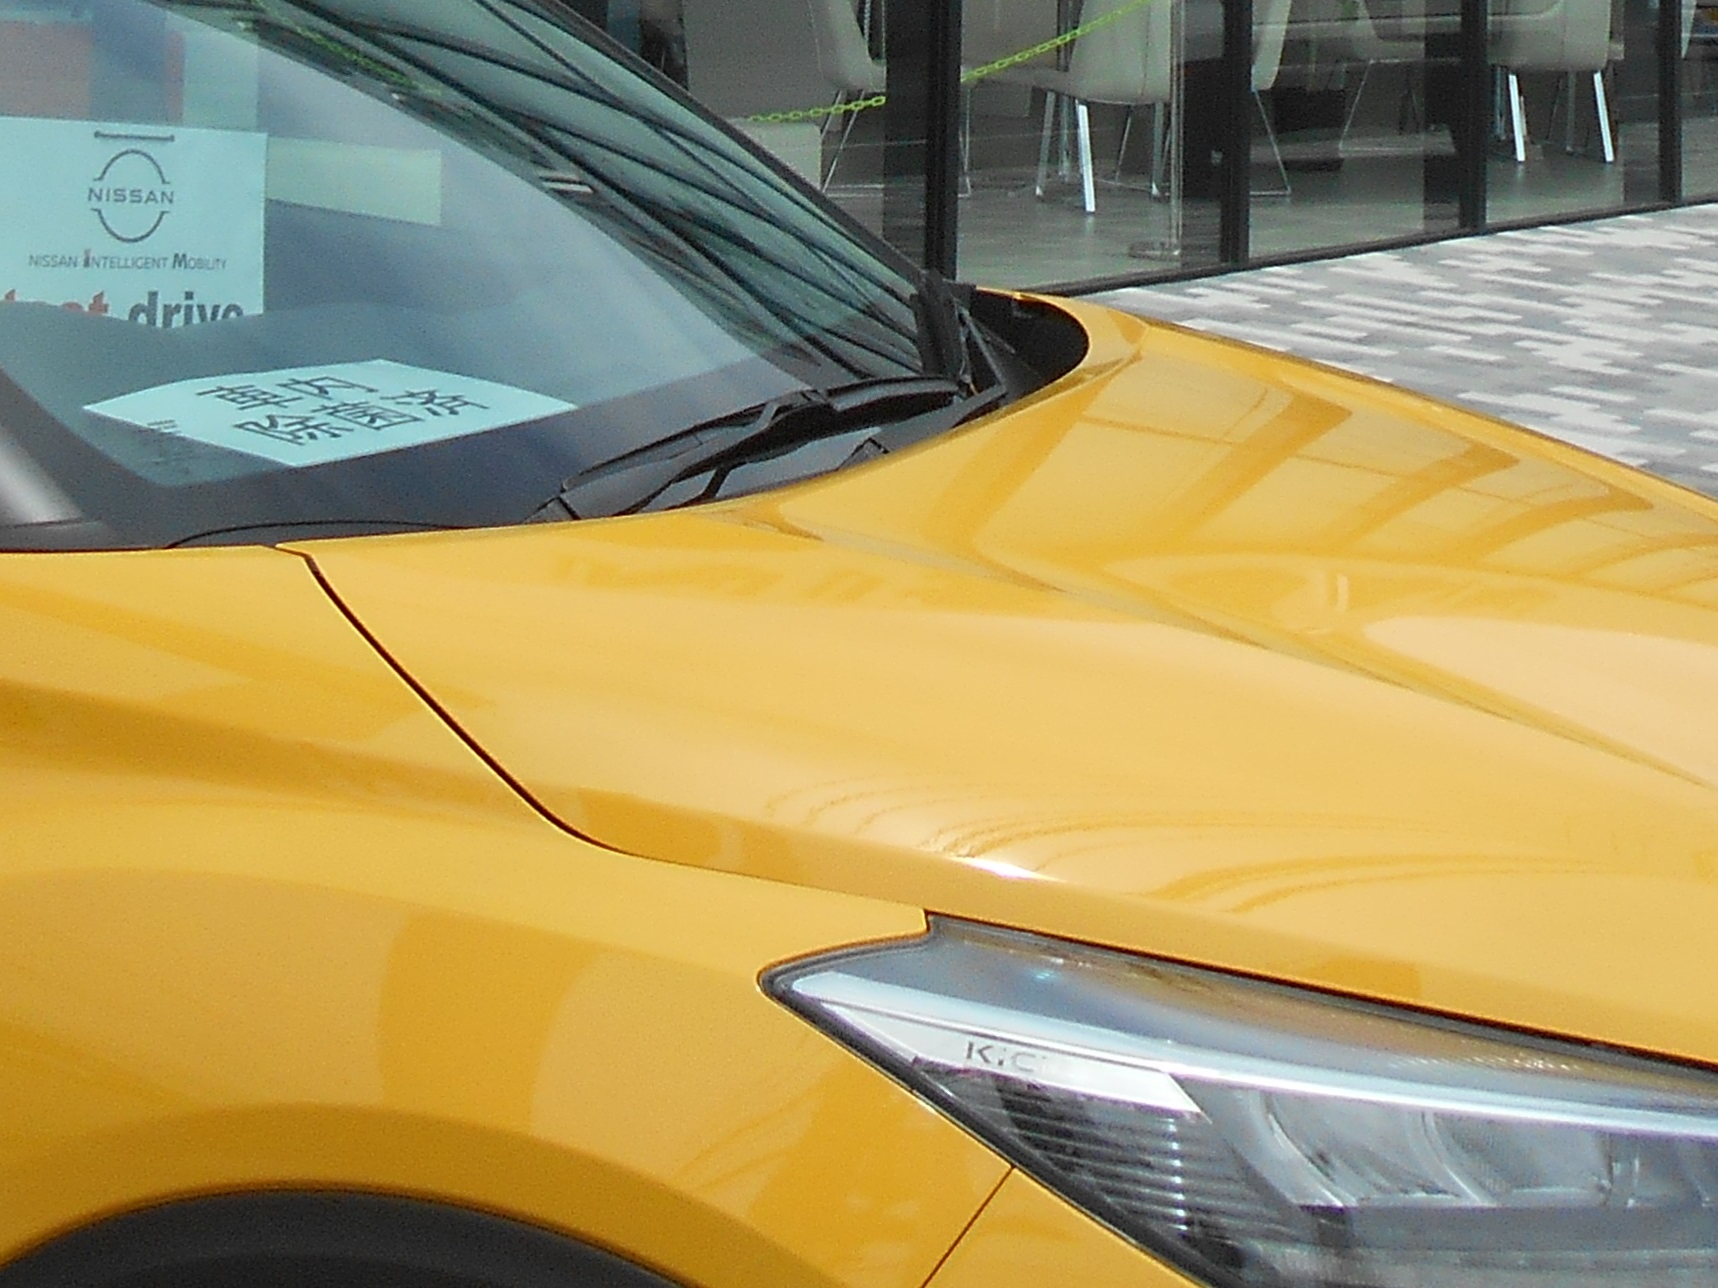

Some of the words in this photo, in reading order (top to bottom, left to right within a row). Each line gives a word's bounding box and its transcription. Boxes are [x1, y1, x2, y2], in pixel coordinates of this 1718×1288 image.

[87, 186, 175, 206] NISSAN
[28, 253, 79, 270] NISSAN
[84, 248, 169, 270] INTELLIGENT
[172, 252, 227, 271] MOBILITY
